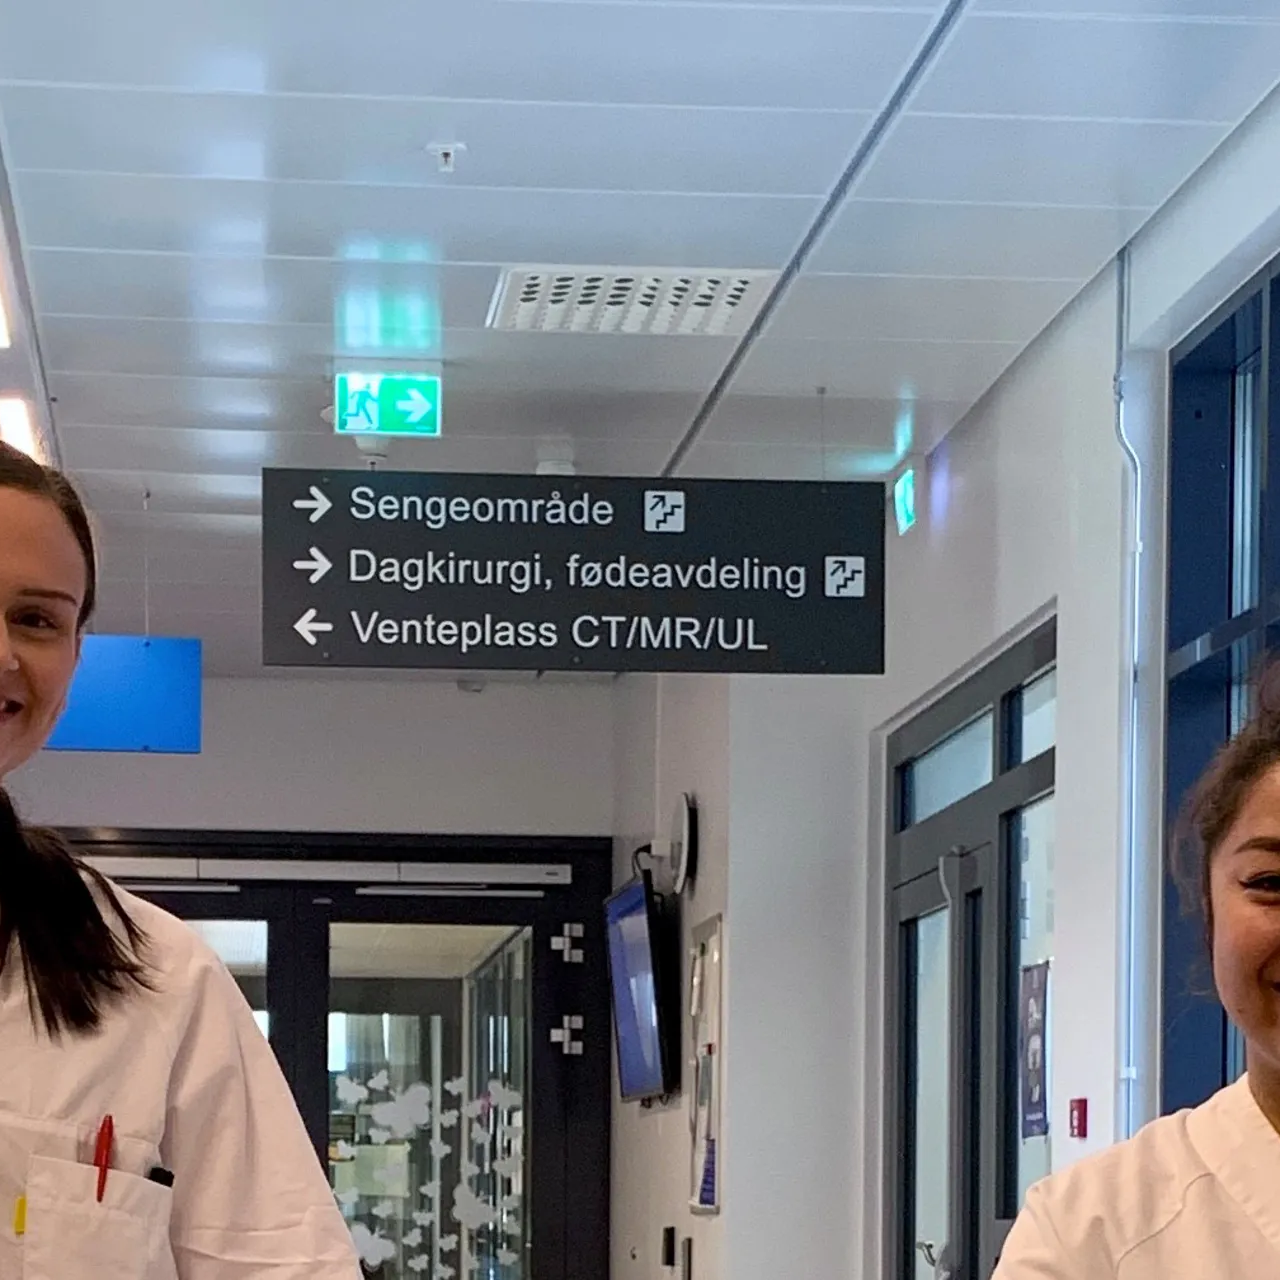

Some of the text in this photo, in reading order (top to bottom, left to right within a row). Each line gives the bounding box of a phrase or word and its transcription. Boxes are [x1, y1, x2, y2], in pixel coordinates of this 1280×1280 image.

[350, 486, 614, 529] Sengeområde
[349, 549, 806, 598] Dagkirurgi, fødeavdeling
[351, 610, 768, 653] Venteplass CT/MR/UL
